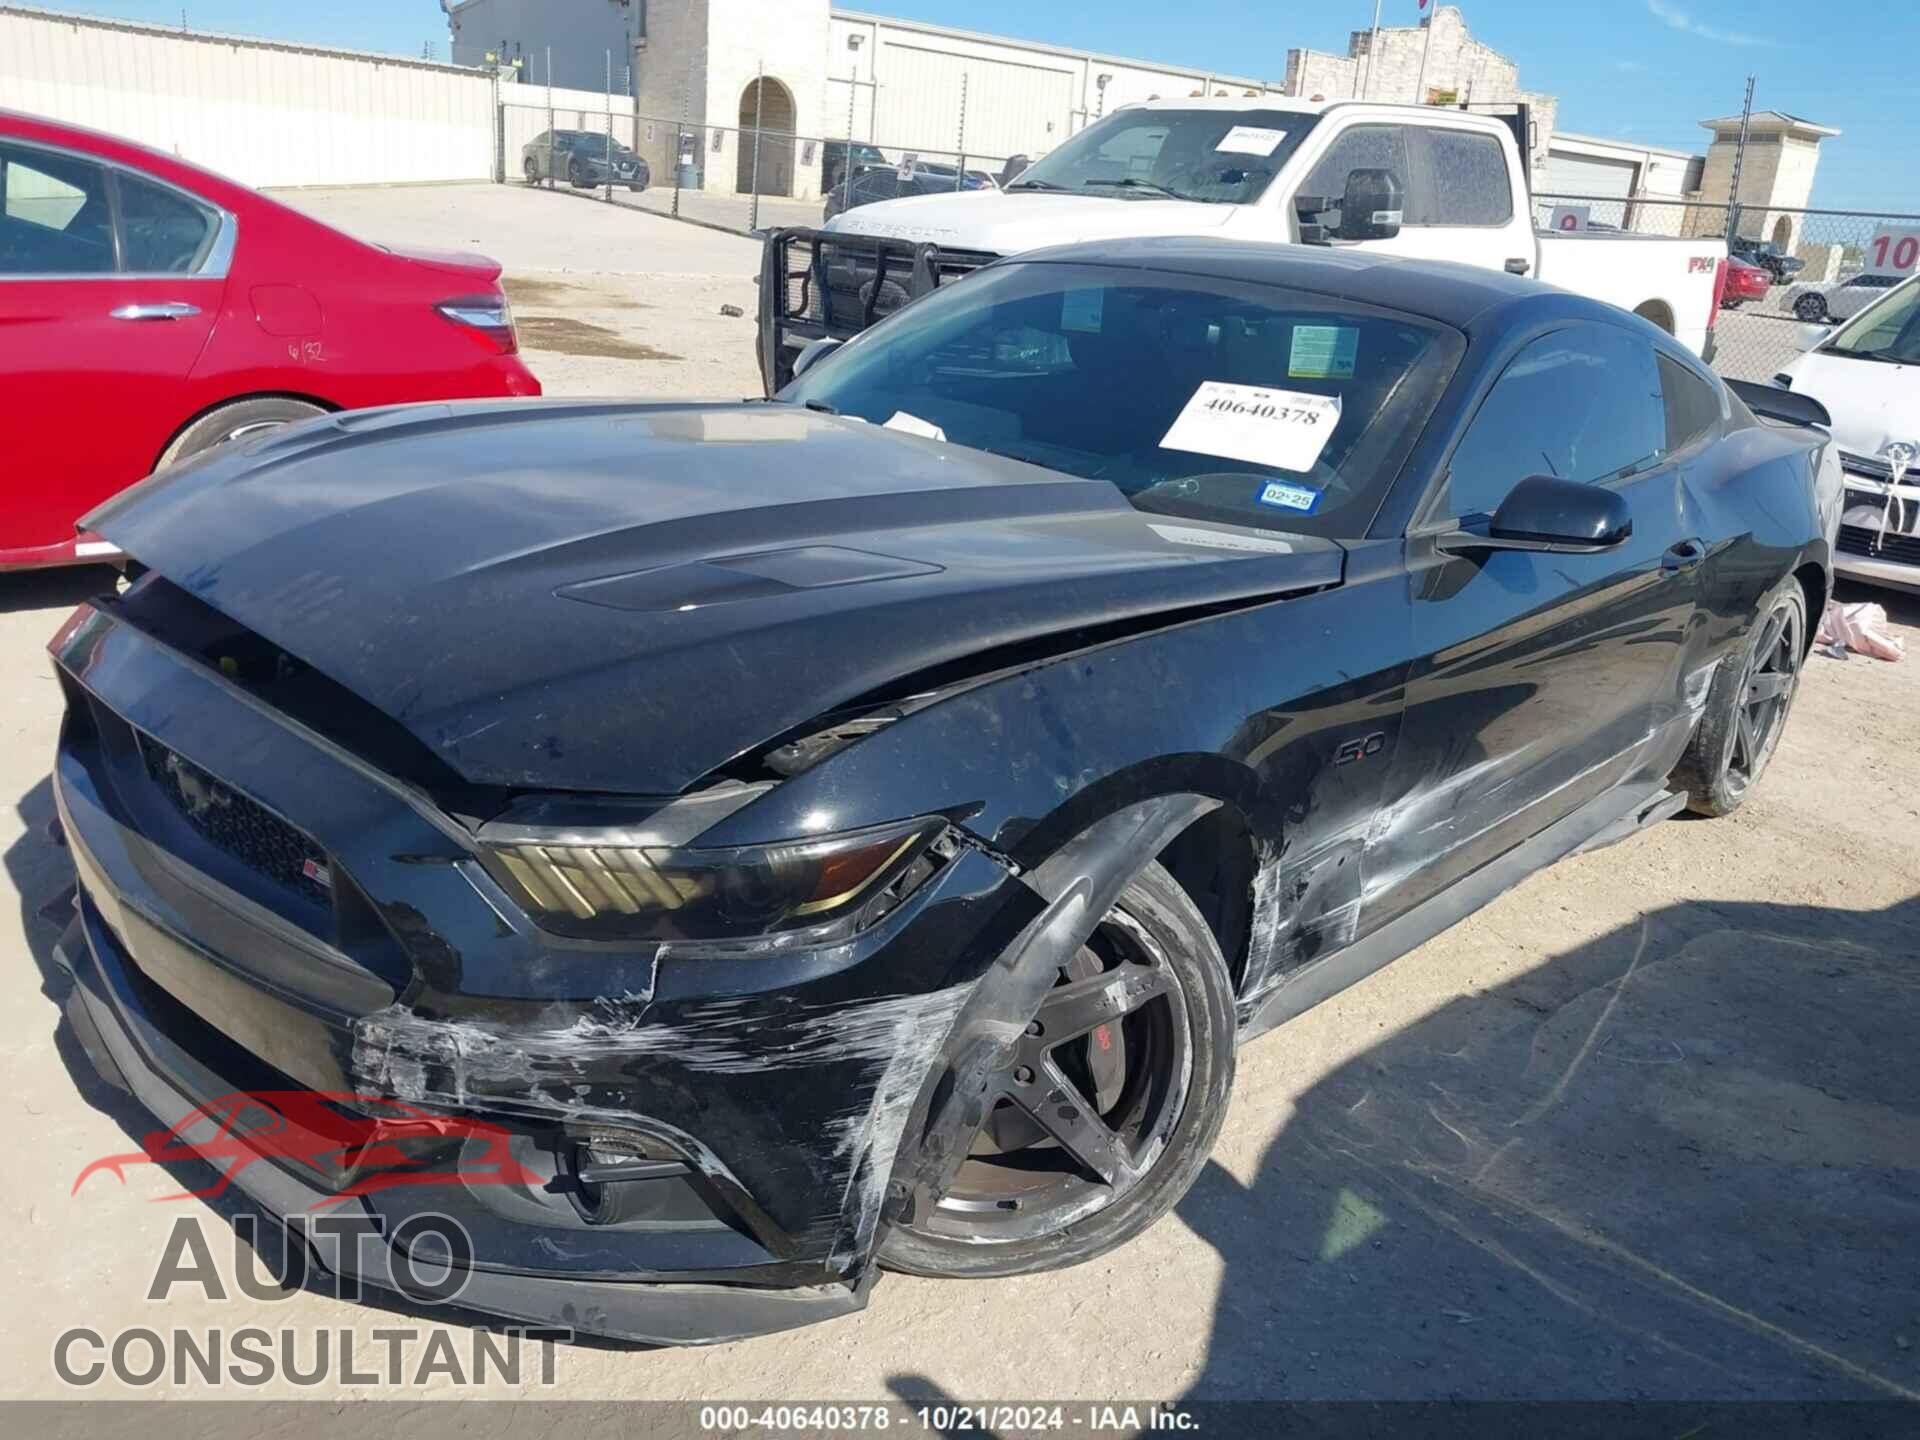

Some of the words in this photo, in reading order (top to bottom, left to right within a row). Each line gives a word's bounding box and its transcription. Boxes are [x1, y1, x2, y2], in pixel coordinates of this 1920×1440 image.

[902, 158, 914, 177] 5
[1874, 235, 1920, 270] 10
[1688, 256, 1715, 274] FX4
[1203, 398, 1320, 425] 40640378
